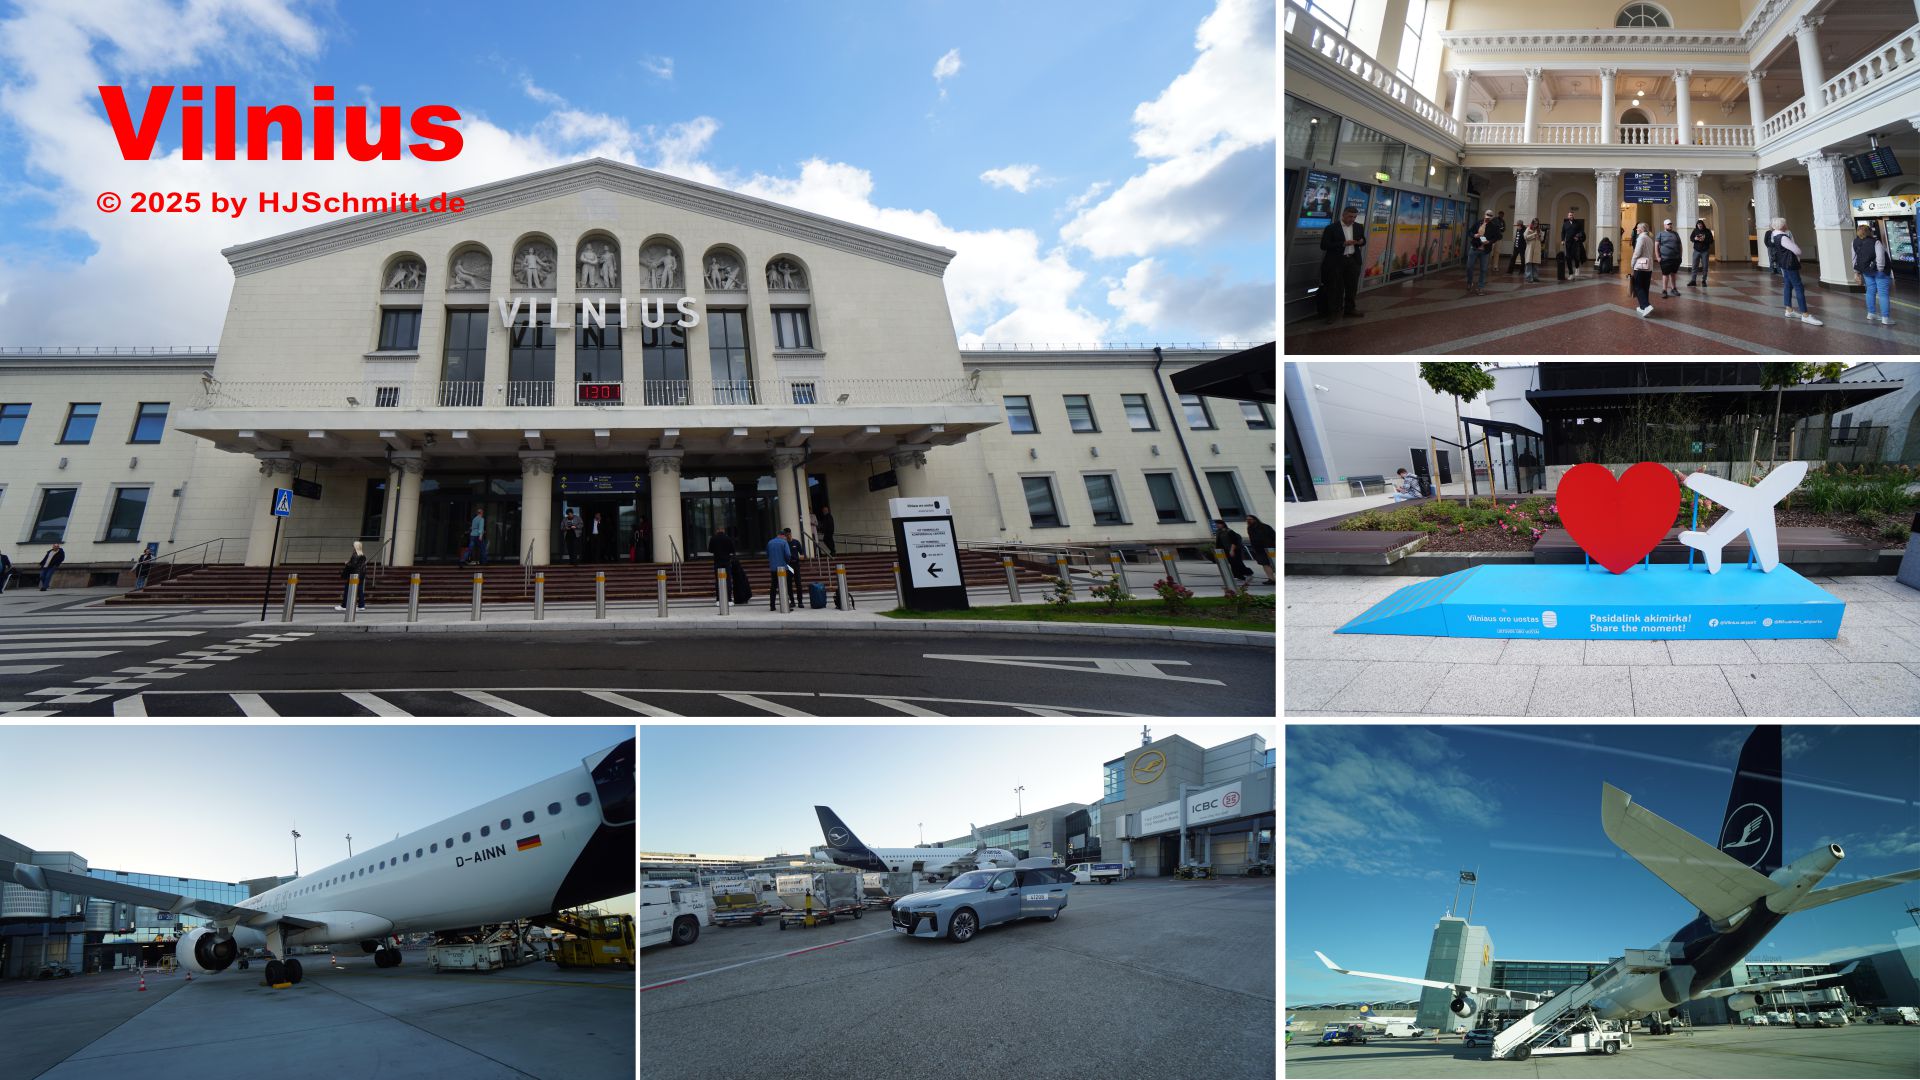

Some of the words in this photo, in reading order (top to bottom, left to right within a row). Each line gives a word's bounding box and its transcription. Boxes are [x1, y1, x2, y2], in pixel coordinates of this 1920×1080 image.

[497, 296, 700, 329] VILNIUS
[1467, 614, 1497, 623] Vilniaus
[1589, 614, 1641, 623] Pasidalink
[1643, 614, 1692, 623] akimirka!
[1590, 624, 1619, 632] Share
[1621, 624, 1638, 632] the
[1641, 624, 1686, 632] moment!
[1192, 799, 1218, 814] ICBC
[455, 843, 507, 868] D-AINN
